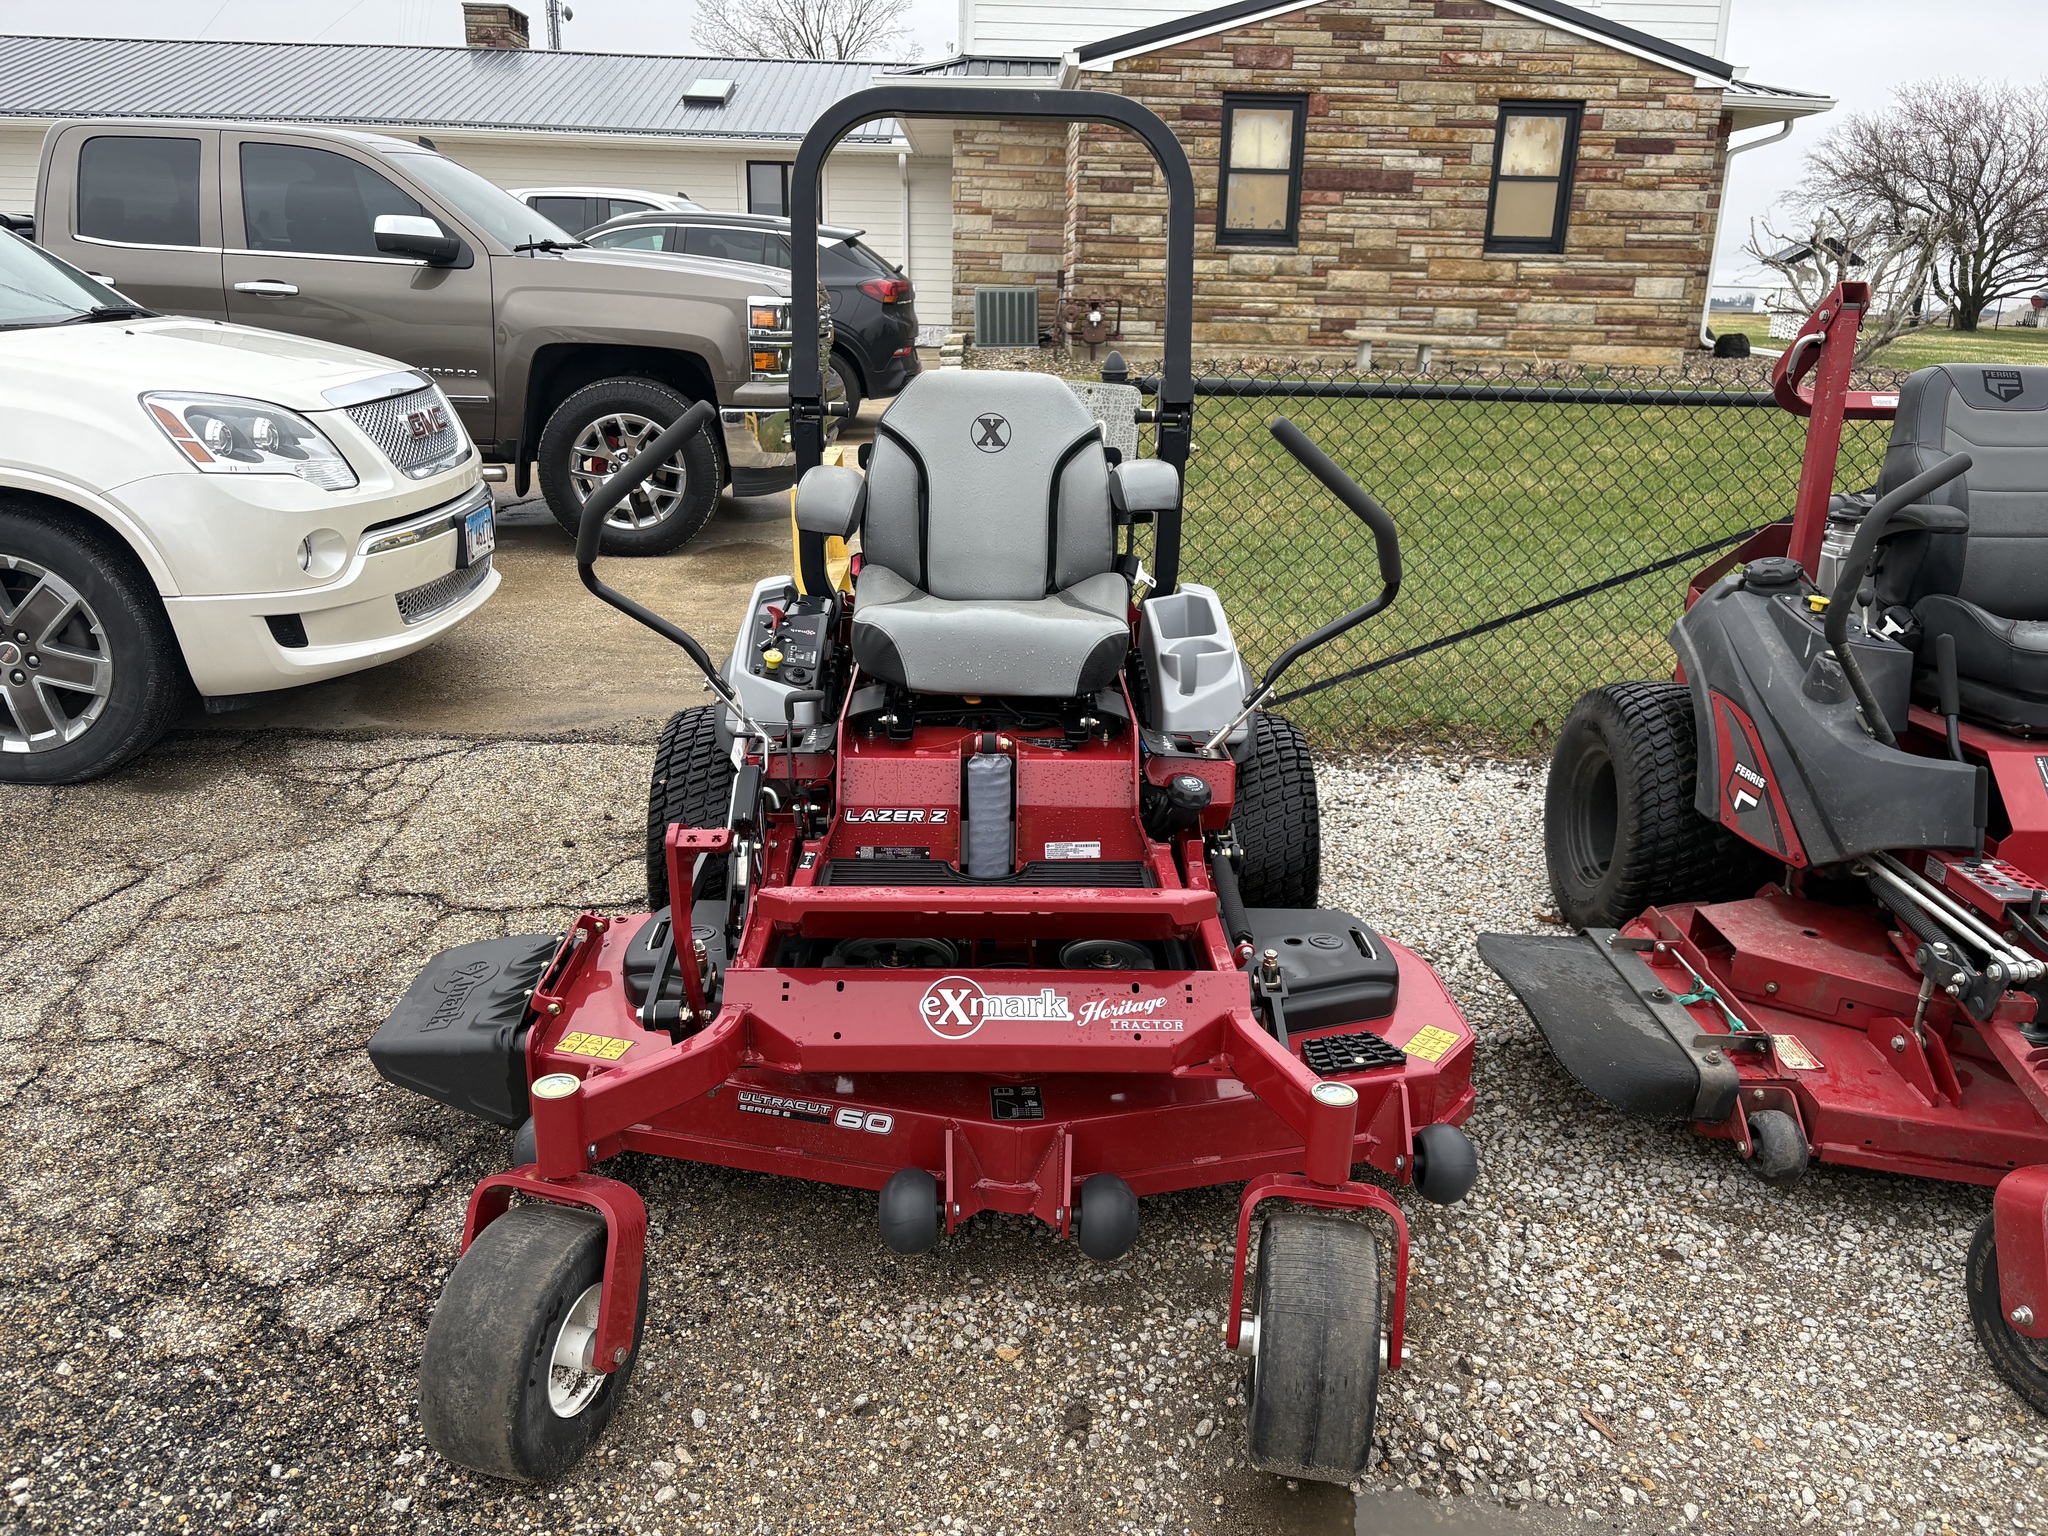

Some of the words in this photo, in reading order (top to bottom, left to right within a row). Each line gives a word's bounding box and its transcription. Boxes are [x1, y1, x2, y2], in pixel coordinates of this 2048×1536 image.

[1984, 370, 2019, 379] FERRIS
[407, 406, 449, 438] GMC
[1734, 762, 1767, 789] FERRIS
[844, 808, 926, 824] LAZER
[928, 808, 949, 824] Z
[920, 984, 1071, 1028] eXmark
[1076, 995, 1168, 1027] Heritage
[1110, 1020, 1185, 1031] TRACTOR
[738, 1103, 781, 1117] SERIES
[738, 1091, 833, 1115] ULTRACUT
[834, 1106, 894, 1135] 60
